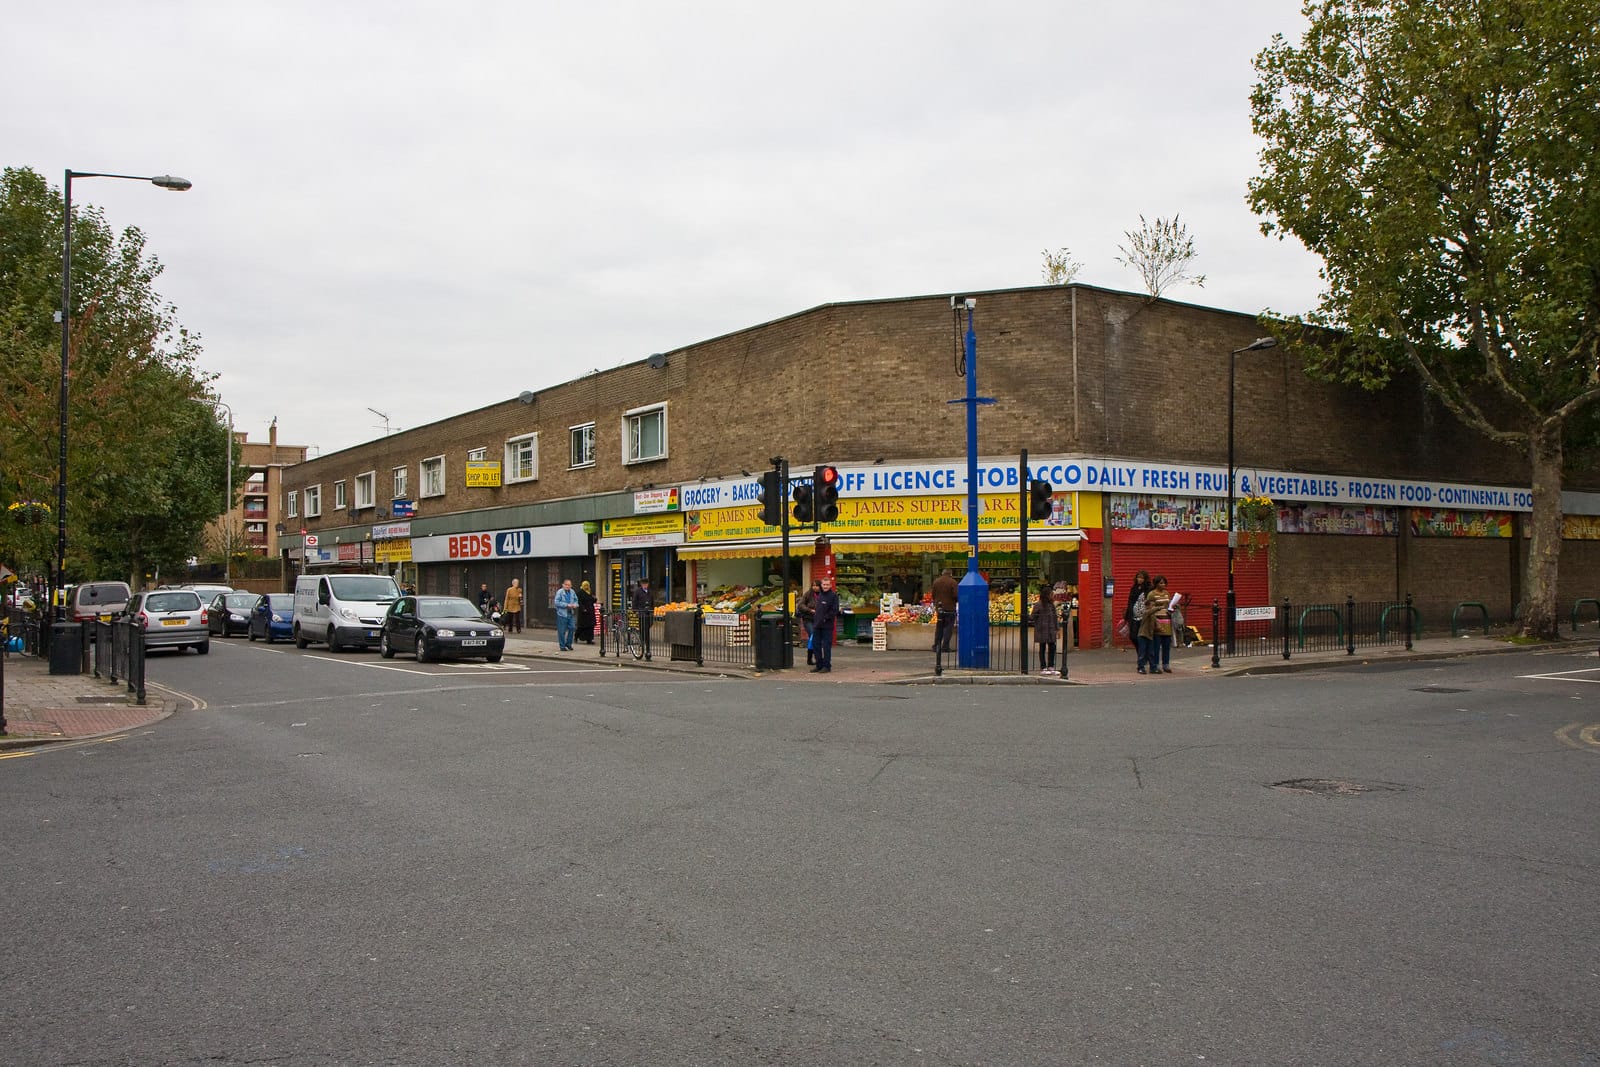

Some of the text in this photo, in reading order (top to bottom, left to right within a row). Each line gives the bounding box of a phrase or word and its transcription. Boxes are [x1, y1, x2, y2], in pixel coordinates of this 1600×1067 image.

[467, 472, 500, 481] SHOP TO LET
[874, 470, 955, 491] LICENCE
[1087, 466, 1533, 507] DAILY FRESH FRUI & VEGETABLES FROZEN FOOD CONTINENTAL FOO
[685, 487, 721, 506] GROCERY
[835, 502, 848, 514] T.
[852, 501, 905, 517] JAMES
[702, 512, 715, 524] ST.
[716, 509, 744, 527] JAMES
[828, 519, 846, 527] FRESH
[847, 519, 864, 527] FRUIT
[868, 518, 902, 526] VEGETABLE
[906, 518, 934, 526] BUTCHER
[939, 517, 962, 526] BAKERY
[977, 517, 996, 525] OCERY
[1151, 512, 1228, 525] OFF LICENC
[1313, 518, 1361, 529] GROCERY
[1434, 521, 1461, 531] FRUIT
[449, 532, 525, 558] BEDS 4U
[961, 543, 992, 551] CRUS
